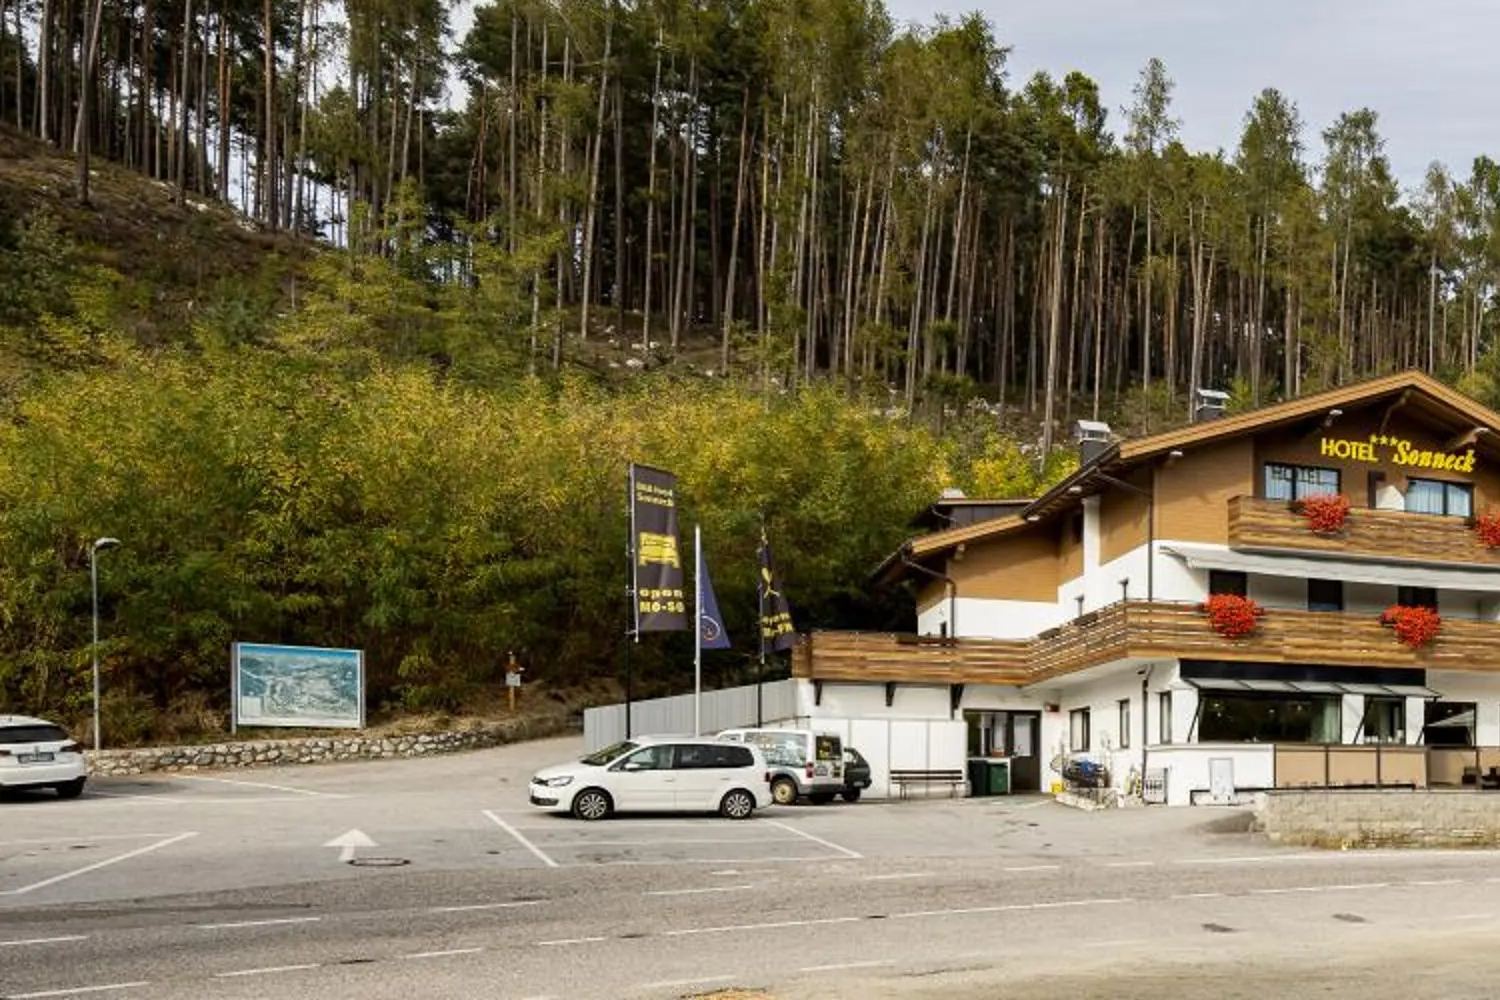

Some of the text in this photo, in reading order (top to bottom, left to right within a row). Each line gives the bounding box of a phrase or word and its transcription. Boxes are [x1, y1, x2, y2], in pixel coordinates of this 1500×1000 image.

[1321, 437, 1476, 473] HOTEL Sonneck
[639, 588, 684, 600] open
